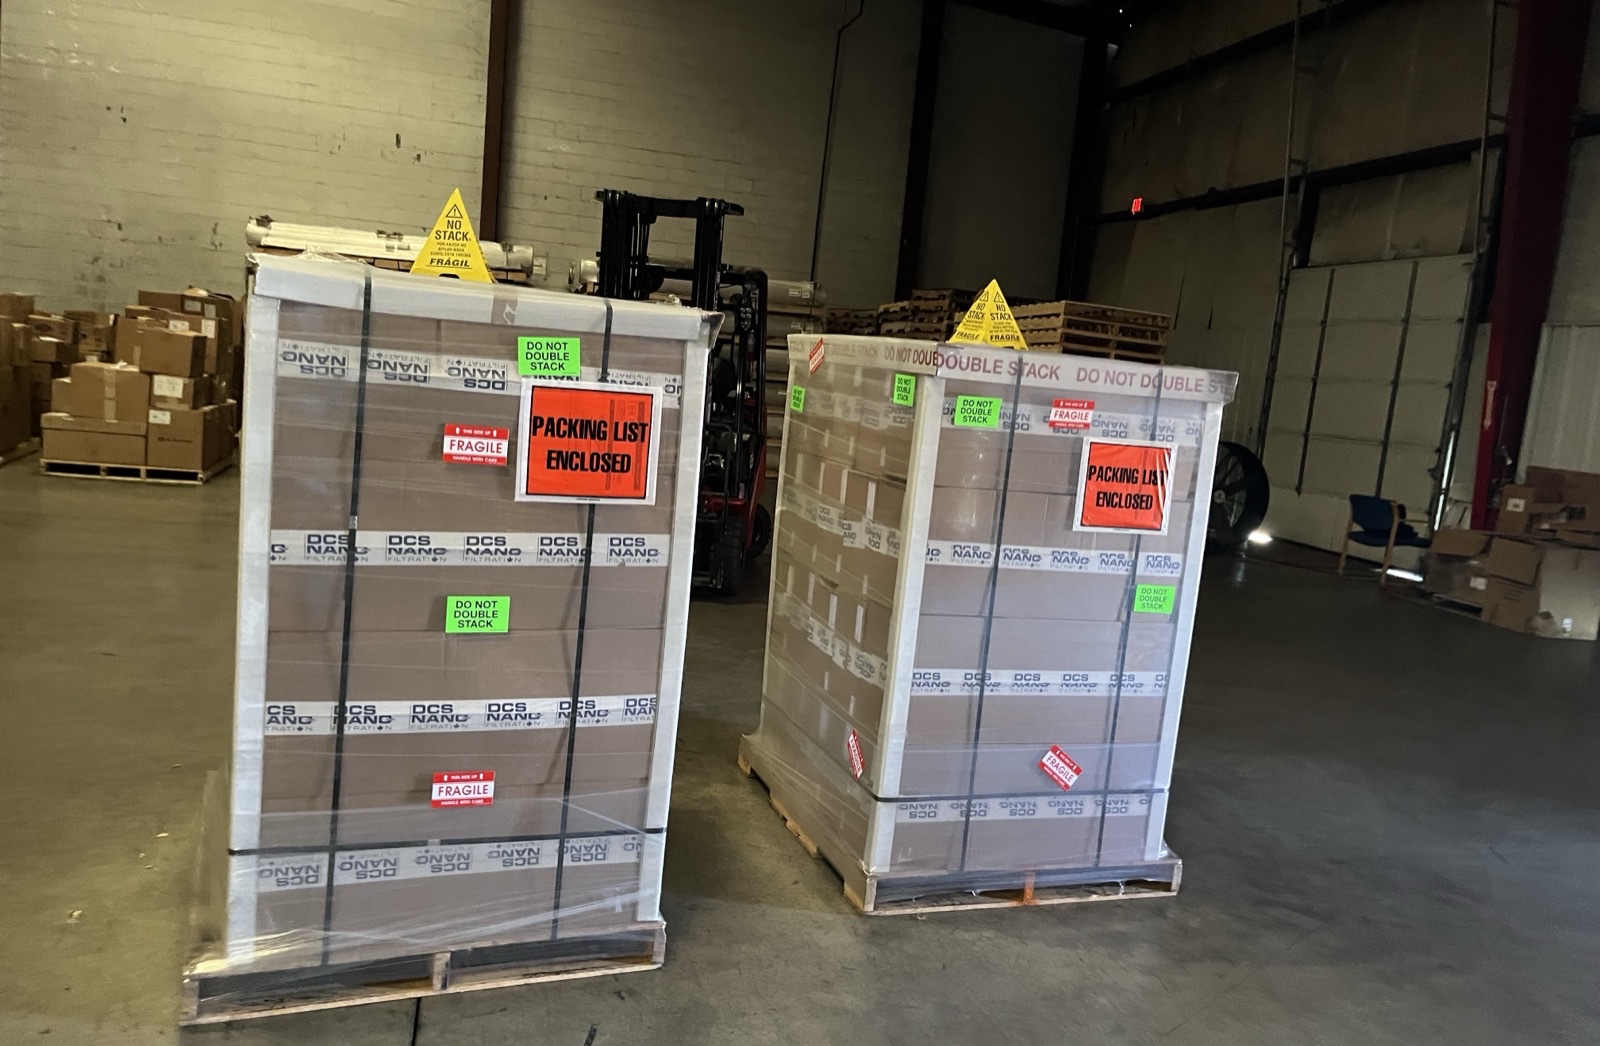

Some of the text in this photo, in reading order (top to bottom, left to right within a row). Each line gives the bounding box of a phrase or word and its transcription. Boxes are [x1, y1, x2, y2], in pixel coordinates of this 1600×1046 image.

[446, 220, 462, 230] NO
[435, 230, 469, 241] STACK
[430, 258, 470, 267] FRÁGIL
[527, 342, 568, 350] DO NOT
[526, 352, 570, 361] DOUBLE
[885, 346, 894, 360] DO
[895, 348, 911, 362] NOT
[300, 364, 346, 378] DCS
[530, 362, 565, 371] STACK
[937, 353, 1061, 380] DOUBLE STACK
[464, 378, 506, 391] DCS
[1076, 367, 1100, 383] DO
[1104, 370, 1138, 387] NOT
[1140, 374, 1204, 392] DOUBLE
[896, 385, 911, 394] DOUBLE
[1054, 410, 1089, 420] FRAGILE
[532, 416, 648, 442] PACKING LIST
[1102, 430, 1128, 438] DCS
[450, 440, 502, 454] FRAGILE
[546, 450, 632, 473] ENCLOSED
[1088, 465, 1139, 485] PACKING
[1096, 491, 1153, 510] ENCLOSED
[308, 534, 349, 545] DCS
[388, 535, 431, 546] DCS
[466, 536, 506, 547] DCS
[540, 536, 578, 547] DCS
[609, 537, 646, 547] DCS
[458, 620, 493, 628] STACK
[267, 705, 296, 715] CS
[412, 704, 453, 714] DCS
[488, 703, 527, 712] DCS
[1046, 756, 1074, 782] FRAGILE
[438, 785, 488, 796] FRAGILE
[503, 857, 539, 867] DCS
[571, 852, 606, 862] DCS
[431, 862, 469, 873] DCS
[356, 868, 397, 879] DCS
[276, 875, 318, 886] DCS
